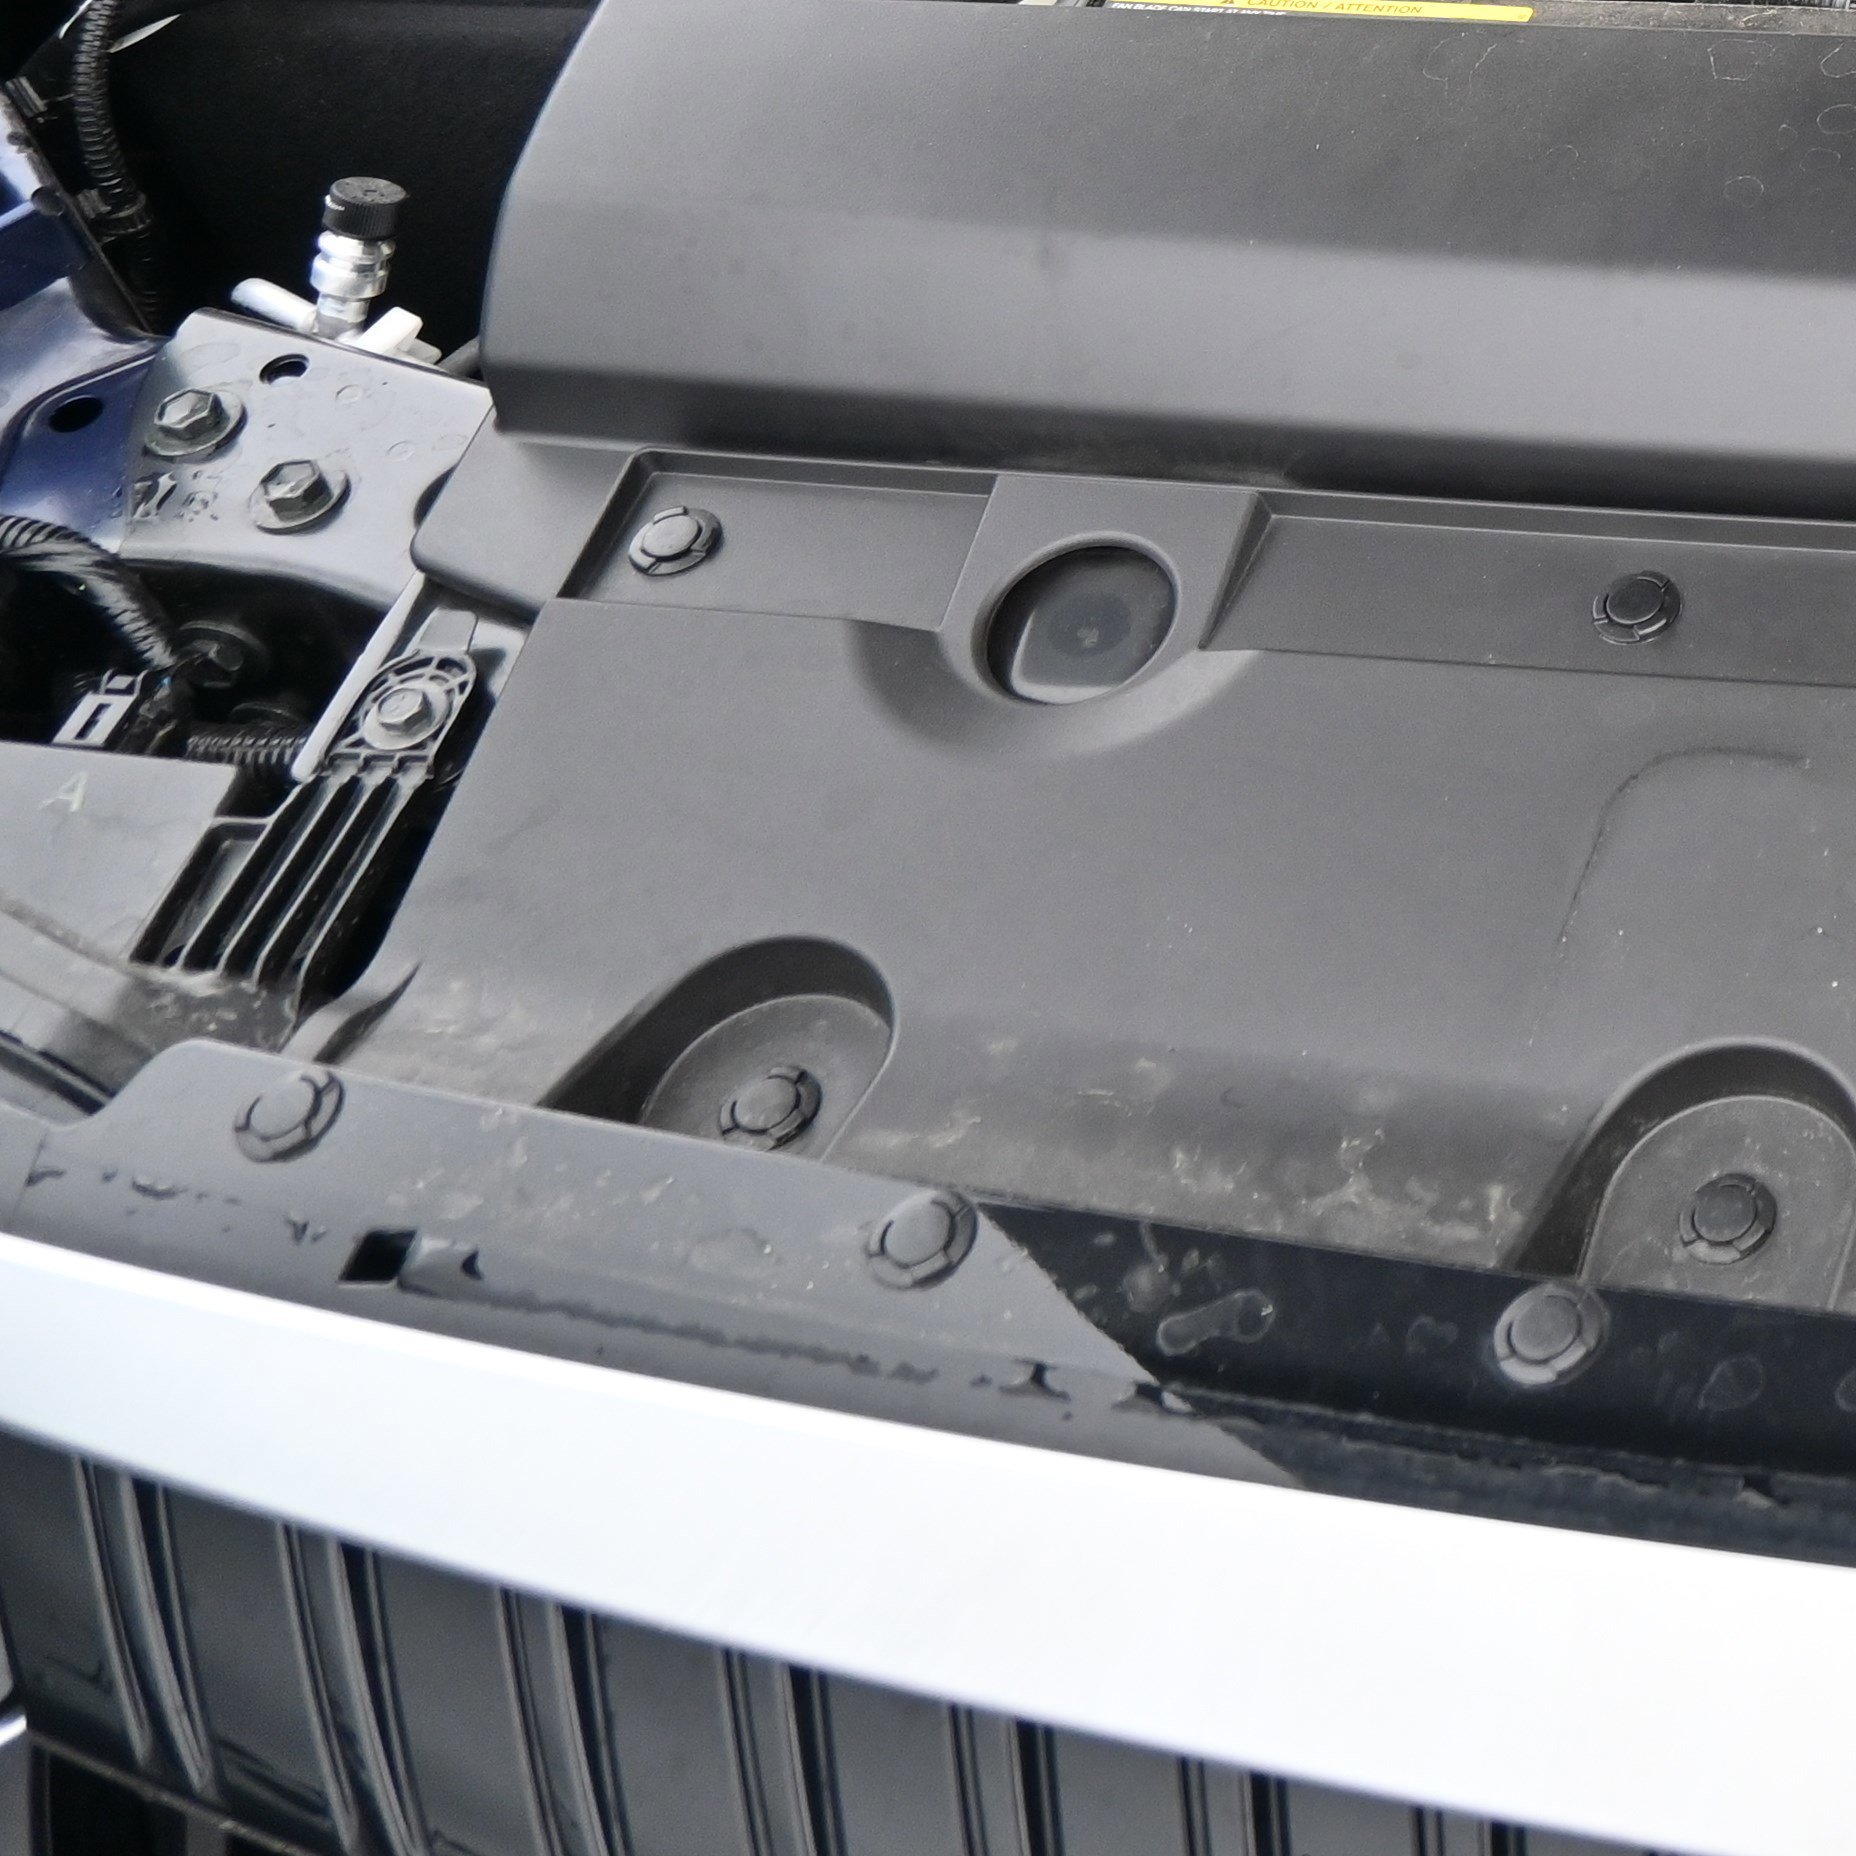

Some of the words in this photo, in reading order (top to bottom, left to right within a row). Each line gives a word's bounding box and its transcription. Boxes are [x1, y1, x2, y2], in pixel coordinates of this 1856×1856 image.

[1111, 2, 1133, 10] FAN
[1335, 3, 1423, 14] ATTENTION
[39, 770, 88, 812] A
